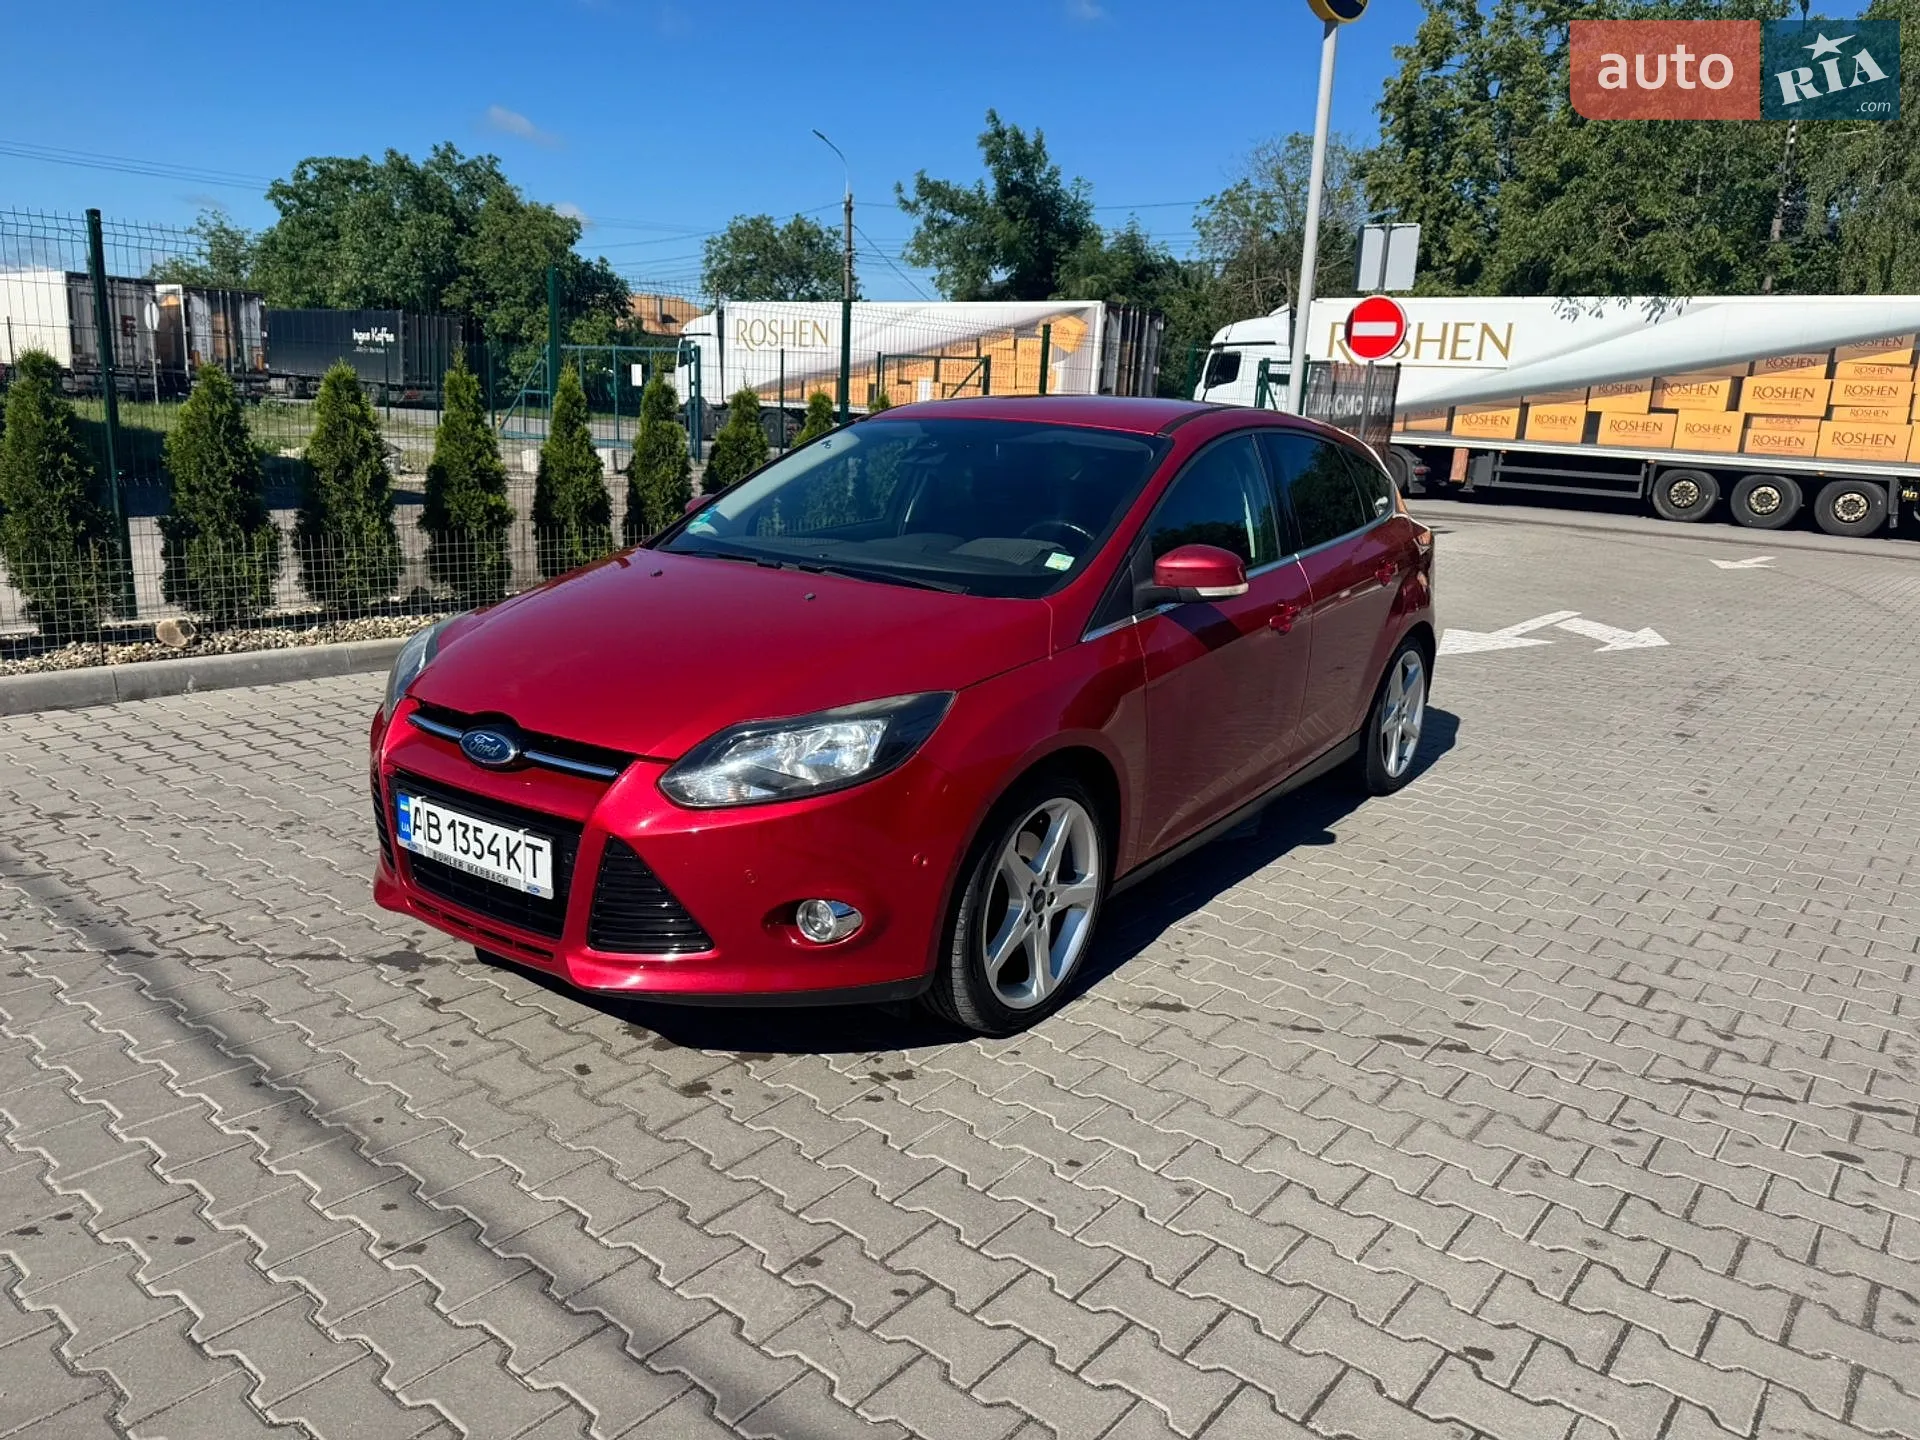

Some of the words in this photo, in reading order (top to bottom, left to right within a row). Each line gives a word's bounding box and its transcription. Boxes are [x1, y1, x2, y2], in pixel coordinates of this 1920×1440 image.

[735, 318, 829, 351] ROSHEN
[1327, 321, 1514, 365] RHEN
[1765, 357, 1817, 369] ROSHEN
[1853, 366, 1894, 376] ROSHEN
[1597, 383, 1643, 394] ROSHEN
[1660, 382, 1720, 396] ROSHEN
[1752, 385, 1816, 400] ROSHEN
[1843, 384, 1899, 397] ROSHEN
[1534, 414, 1577, 425] ROSHEN
[1849, 408, 1890, 418] ROSHEN
[1461, 413, 1511, 427] ROSHEN
[1609, 419, 1663, 433] ROSHEN
[1683, 422, 1732, 434] ROSHEN
[1752, 434, 1806, 447] ROSHEN
[1831, 431, 1897, 447] ROSHEN
[468, 733, 501, 758] Ford
[401, 821, 411, 833] UA
